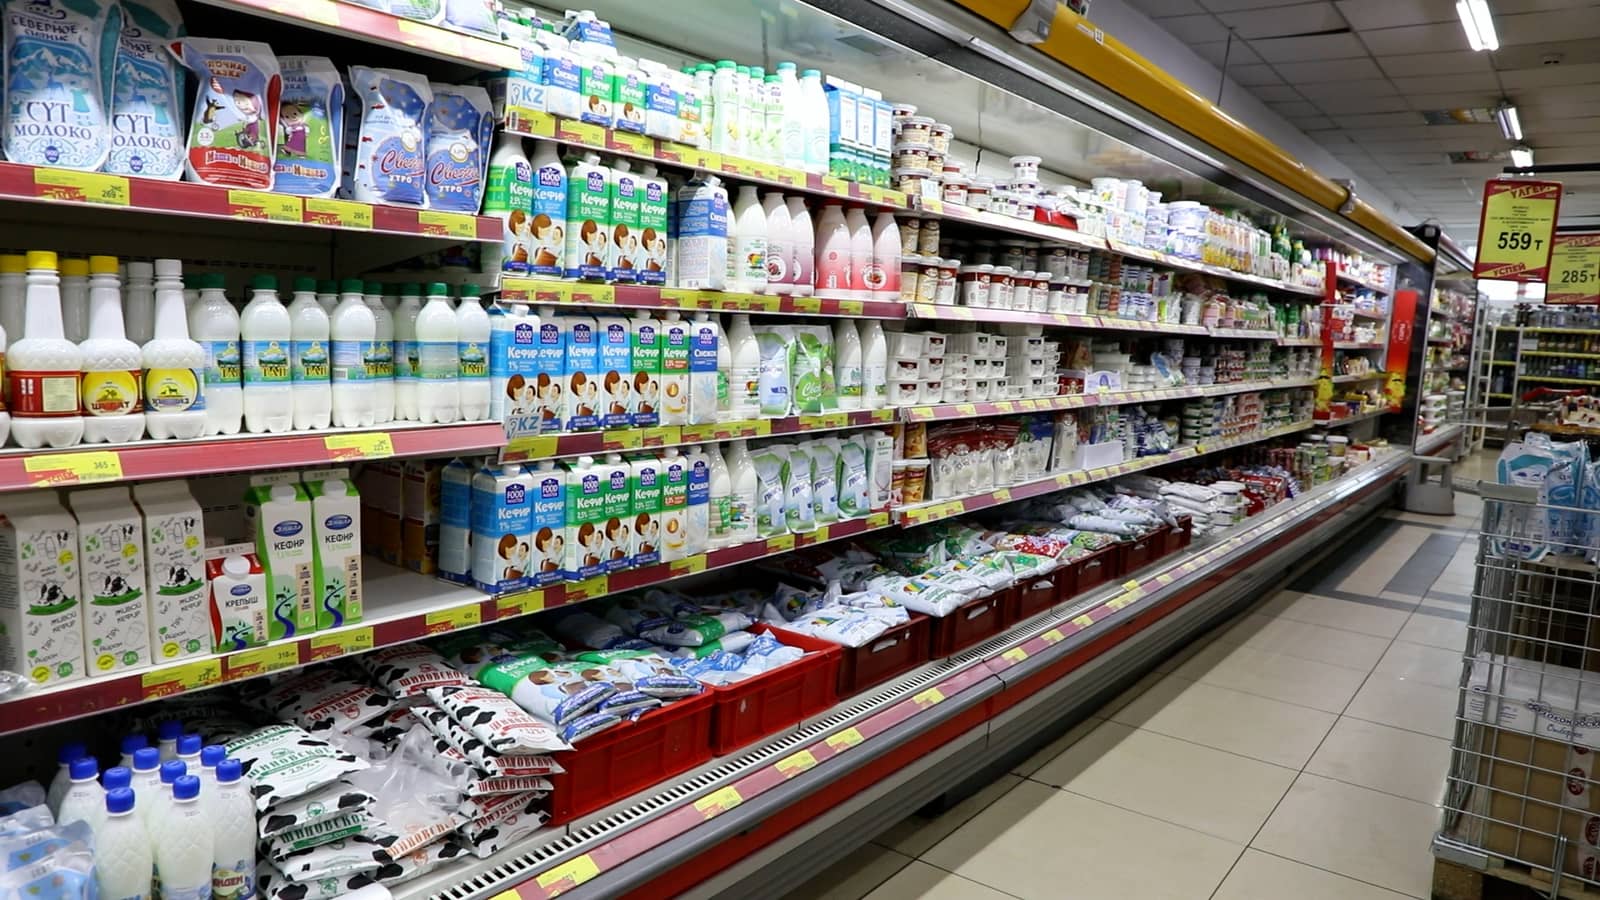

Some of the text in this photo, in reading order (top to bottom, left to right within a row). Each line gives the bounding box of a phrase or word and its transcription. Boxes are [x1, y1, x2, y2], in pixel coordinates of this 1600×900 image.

[11, 15, 78, 34] СЕВЕРНОЕ
[522, 86, 544, 104] KZ
[14, 124, 92, 140] МОЛОКО
[114, 135, 171, 150] ОЛОКО
[541, 173, 560, 181] FOOD
[581, 192, 608, 206] Кефир
[1497, 232, 1532, 250] 559
[1561, 270, 1588, 283] 285
[508, 347, 537, 358] Кефир
[539, 349, 564, 358] ефир
[569, 345, 597, 357] Кефир
[602, 345, 629, 357] Кефир
[633, 346, 659, 357] Кефир
[664, 348, 688, 358] Кефир
[518, 416, 539, 432] KZ
[543, 485, 558, 494] FOOD
[584, 481, 598, 489] FOOD
[663, 485, 686, 495] Кефир
[507, 491, 524, 499] FOOD
[605, 493, 630, 504] Кефир
[634, 488, 660, 499] Кефир
[534, 501, 564, 513] Кефир
[577, 497, 604, 509] Кефир
[498, 507, 531, 519] Кефир
[325, 532, 354, 543] КЕФИР
[274, 540, 305, 551] КЕФИР
[224, 597, 259, 608] КРЕПЫШ
